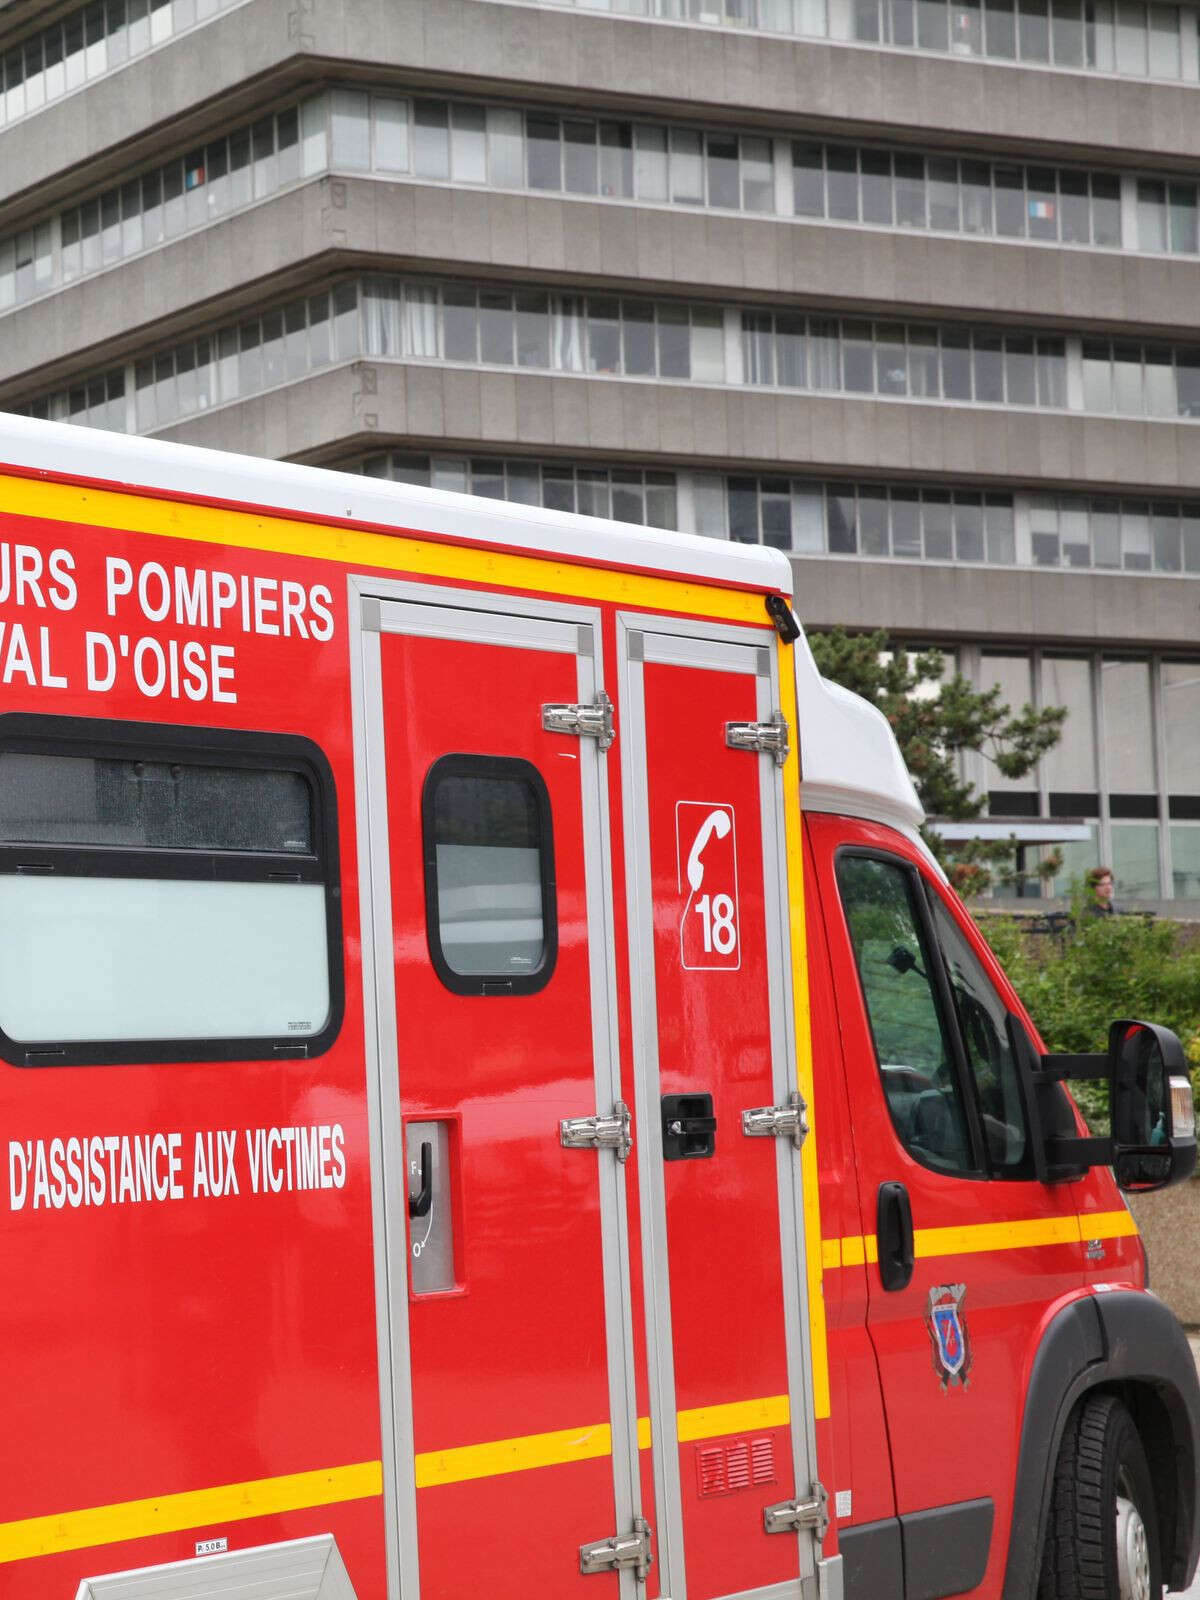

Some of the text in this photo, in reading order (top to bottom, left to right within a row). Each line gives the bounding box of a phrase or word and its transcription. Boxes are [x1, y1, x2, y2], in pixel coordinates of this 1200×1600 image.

[105, 556, 335, 642] POMPIERS
[85, 631, 238, 704] D'OISE
[695, 893, 737, 955] 18
[8, 1132, 184, 1211] D'ASSISTANCE
[193, 1130, 240, 1198] AUX
[245, 1123, 346, 1194] VICTIMES
[411, 1161, 417, 1175] F
